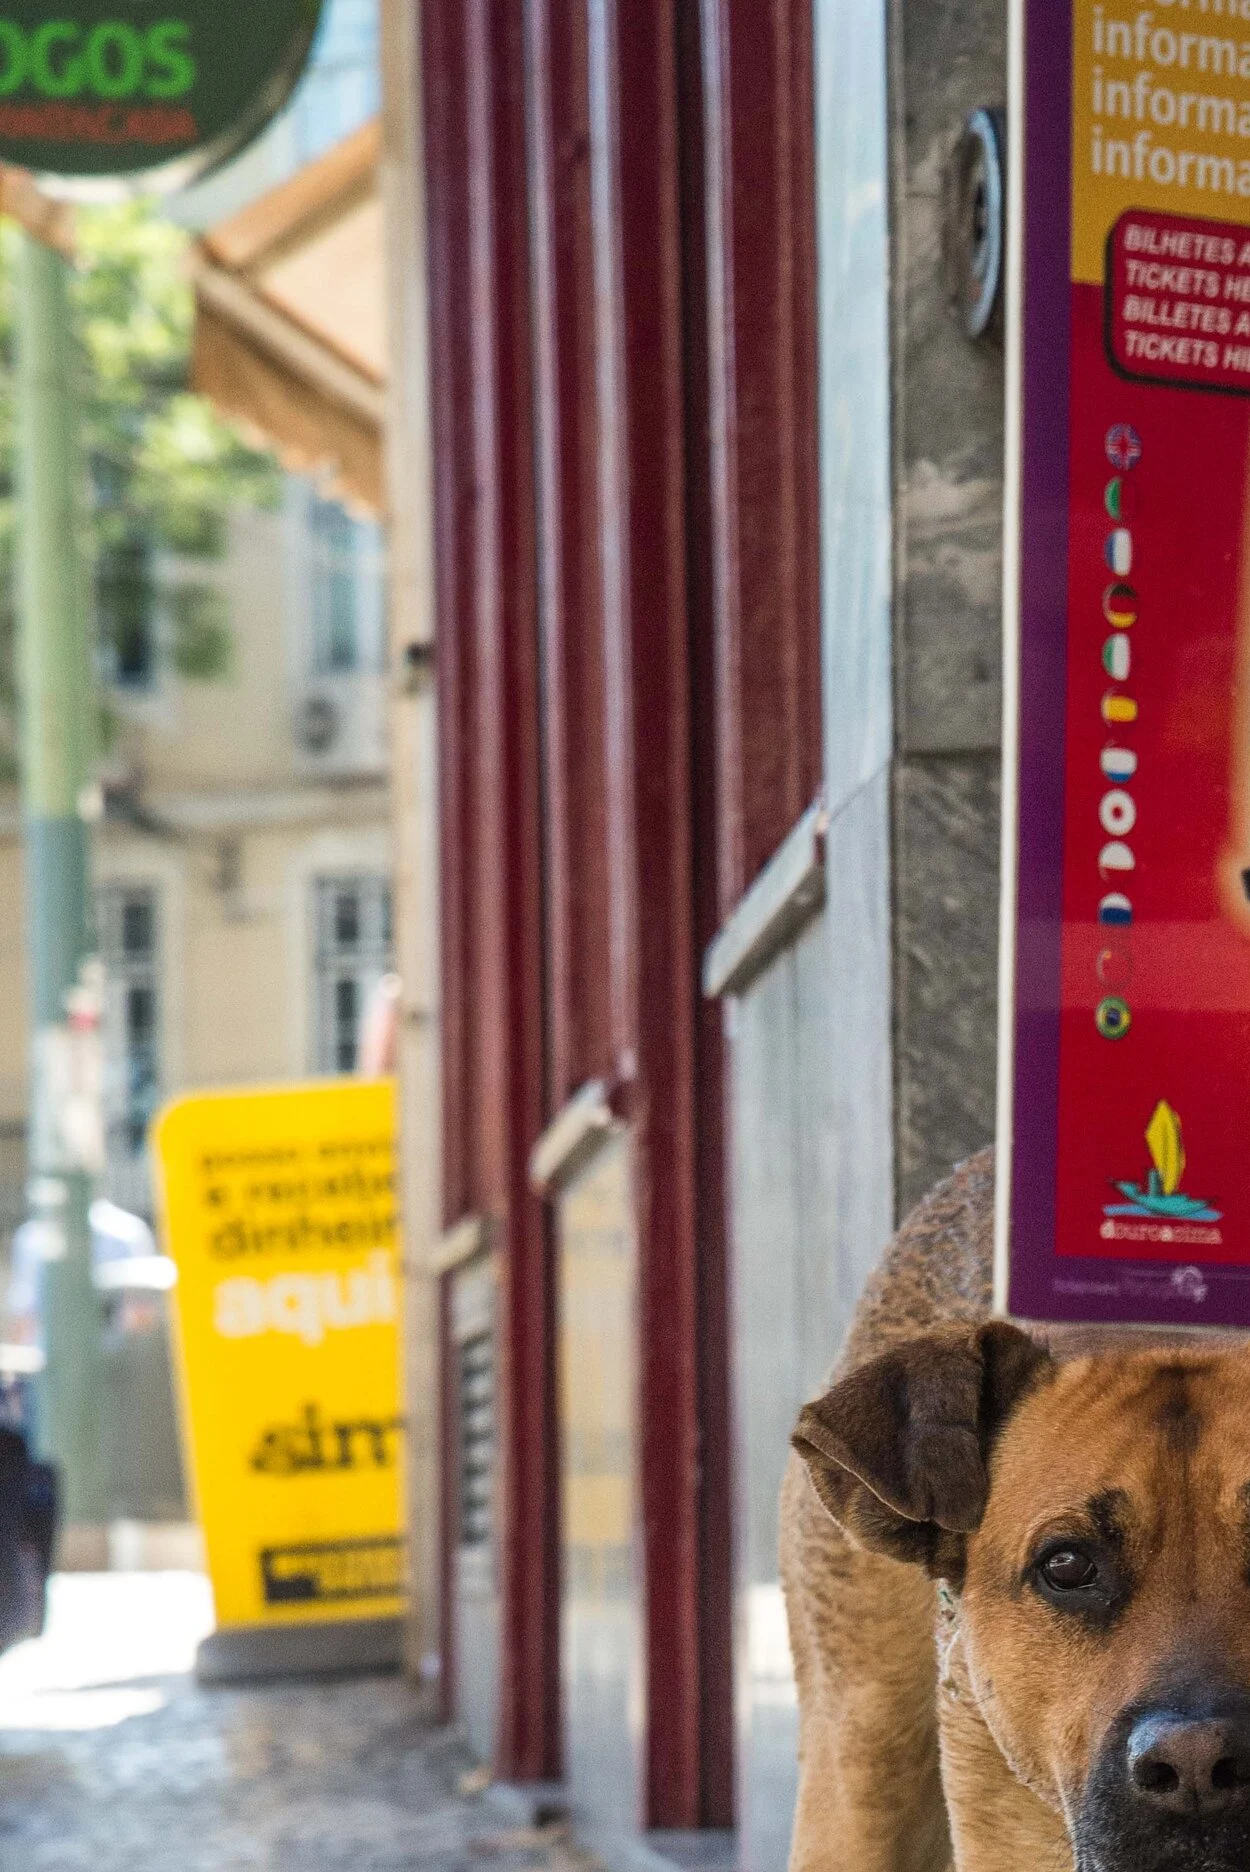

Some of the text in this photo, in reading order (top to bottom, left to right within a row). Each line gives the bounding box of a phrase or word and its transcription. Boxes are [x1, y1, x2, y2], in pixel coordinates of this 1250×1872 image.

[1123, 223, 1237, 265] BILHETES
[1125, 257, 1221, 299] TICKETS
[1121, 293, 1233, 335] BILLETES
[1123, 328, 1219, 369] TICKETS
[213, 1248, 397, 1348] aqui
